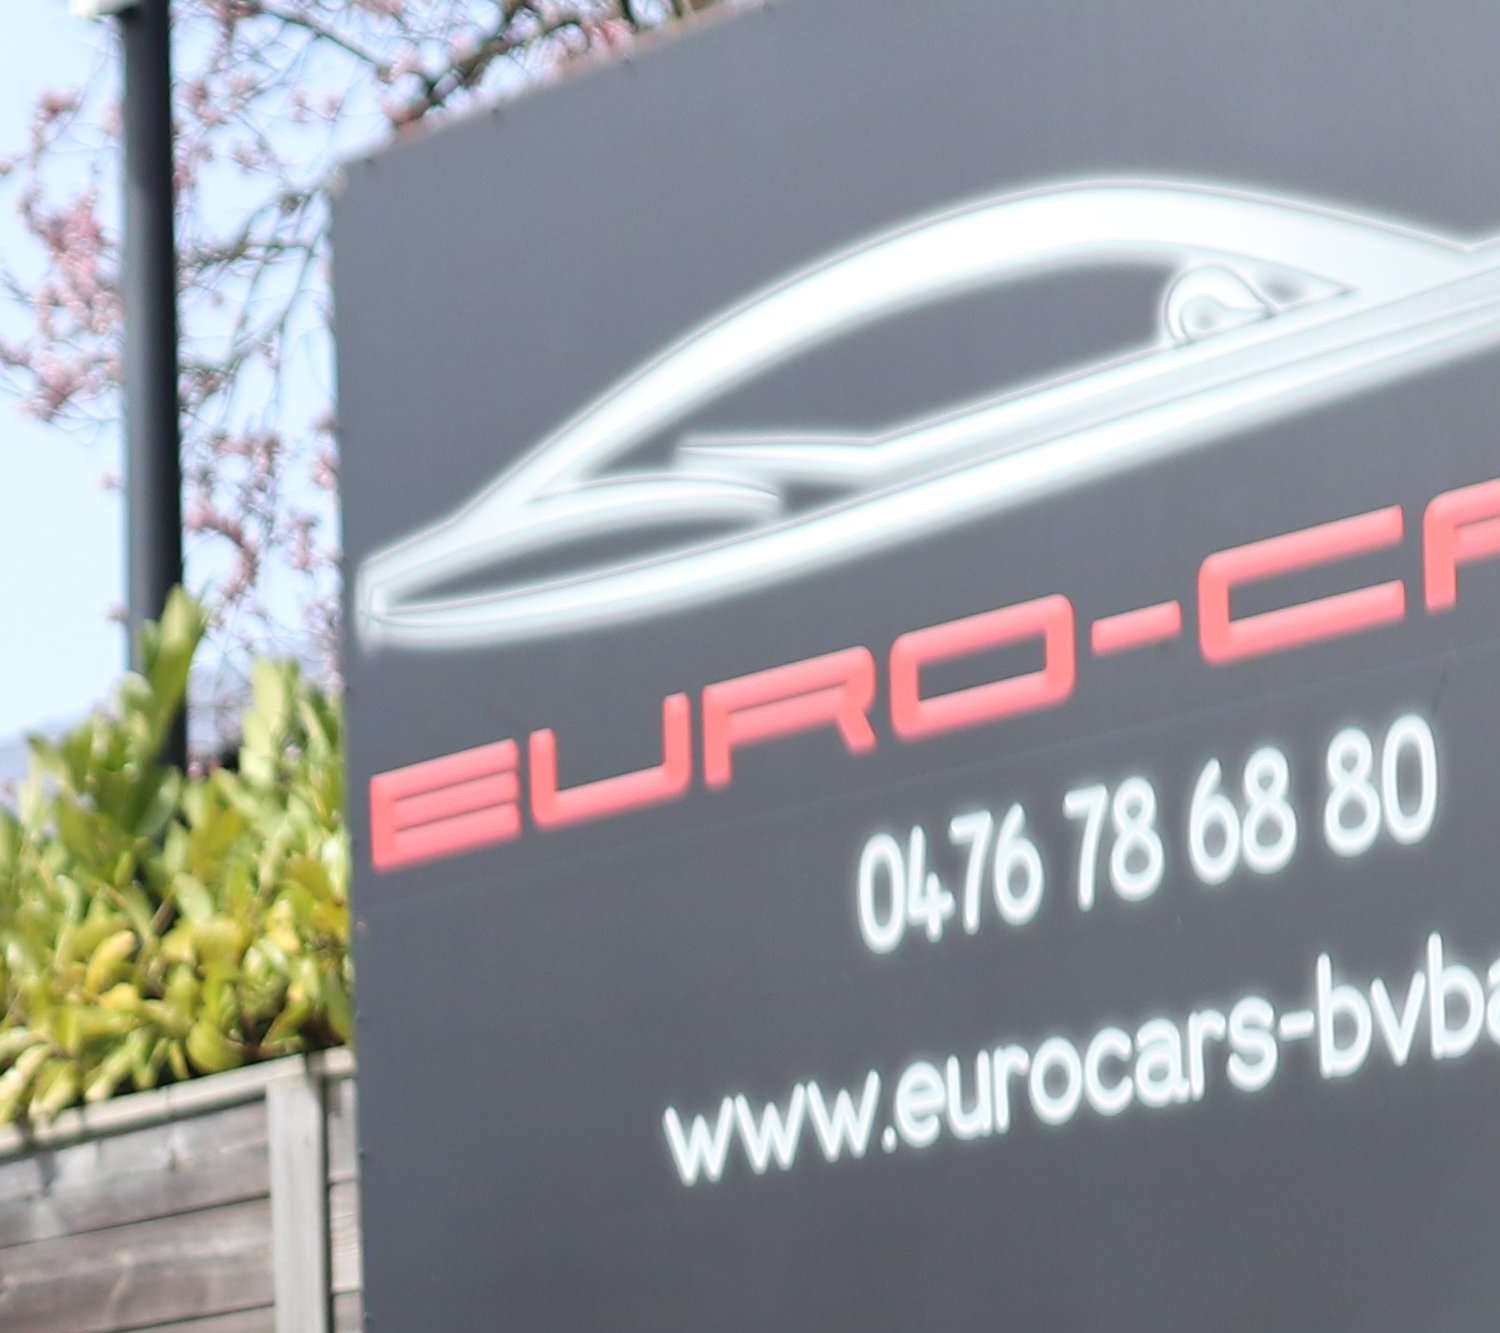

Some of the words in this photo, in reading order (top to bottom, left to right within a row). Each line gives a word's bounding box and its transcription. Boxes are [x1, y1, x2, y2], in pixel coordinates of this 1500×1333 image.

[852, 800, 1046, 957] 0476
[1059, 772, 1168, 913] 78
[1184, 743, 1301, 888] 68
[1320, 710, 1441, 860] 80
